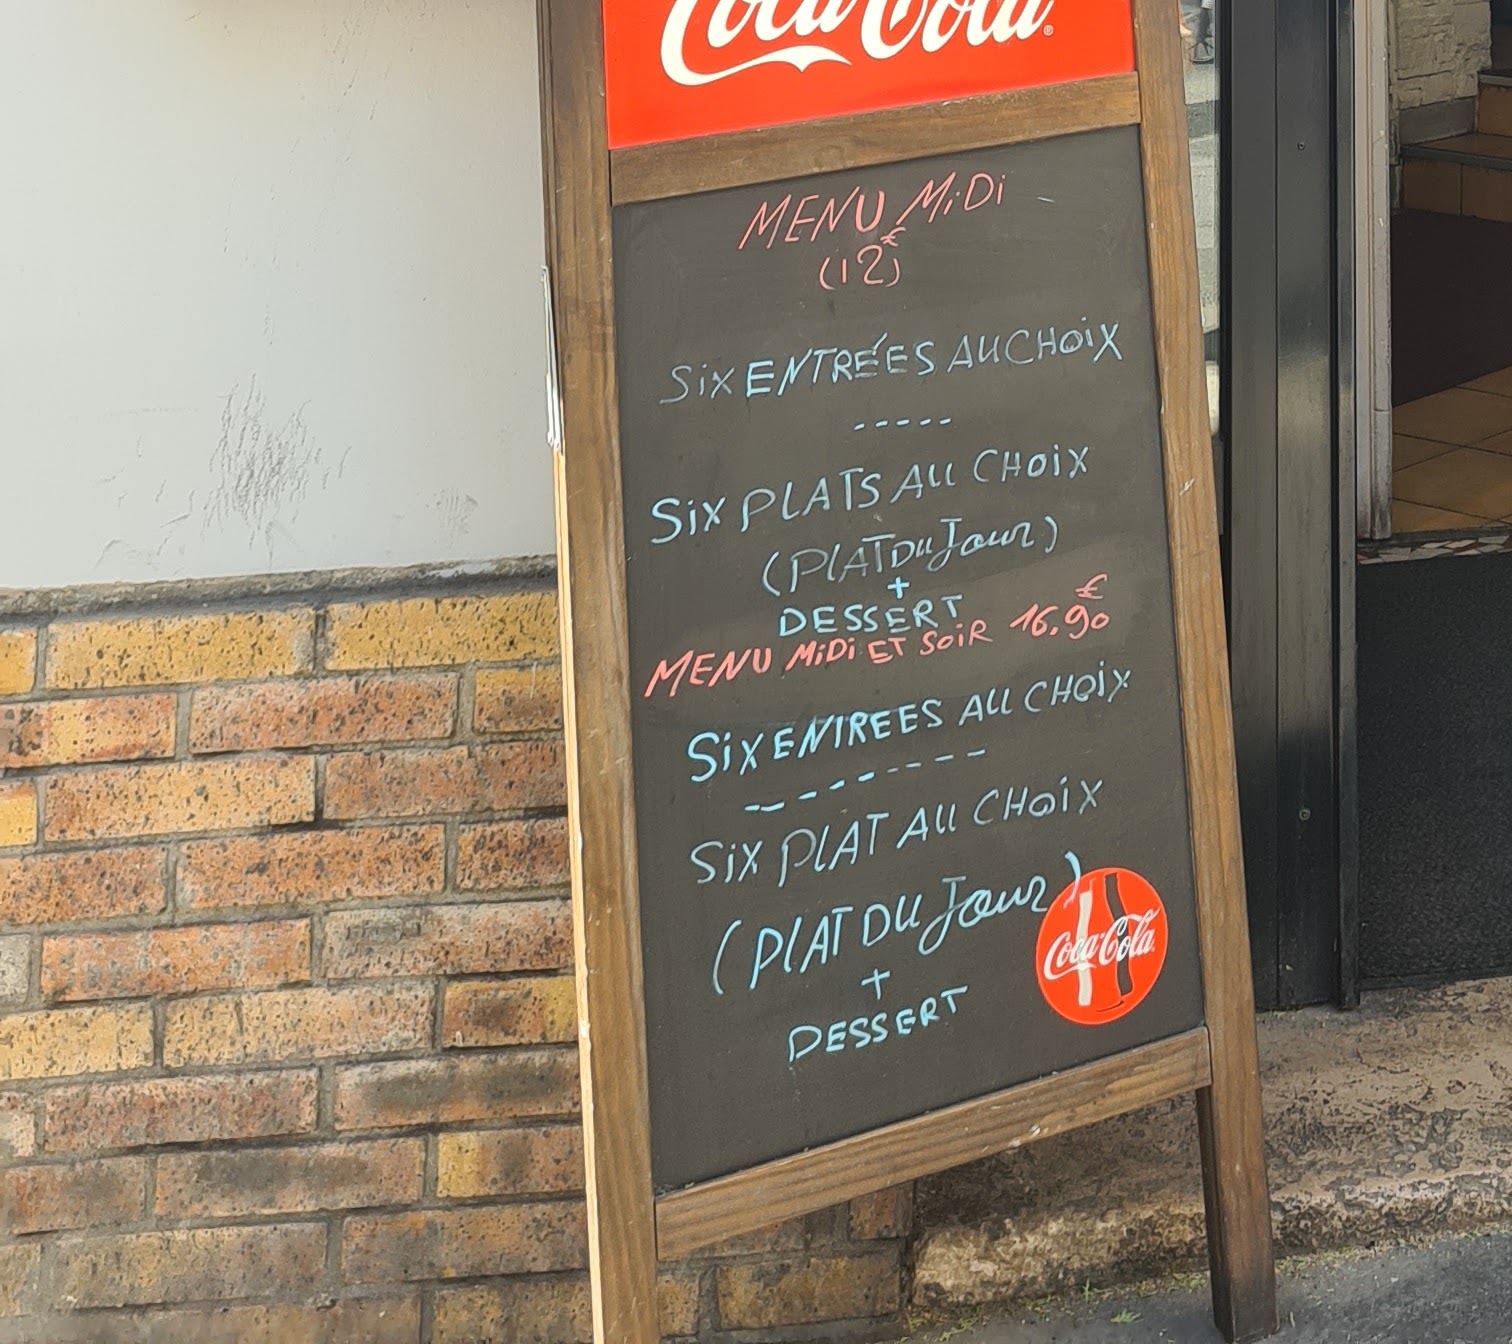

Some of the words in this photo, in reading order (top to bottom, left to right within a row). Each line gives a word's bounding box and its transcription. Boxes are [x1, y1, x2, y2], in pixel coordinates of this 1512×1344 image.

[739, 186, 886, 249] MENU
[779, 594, 964, 638] DESSERT
[643, 648, 772, 698] MENU
[867, 636, 907, 666] ET
[1043, 906, 1161, 981] Coca-Cola
[788, 984, 969, 1063] DESSERT
